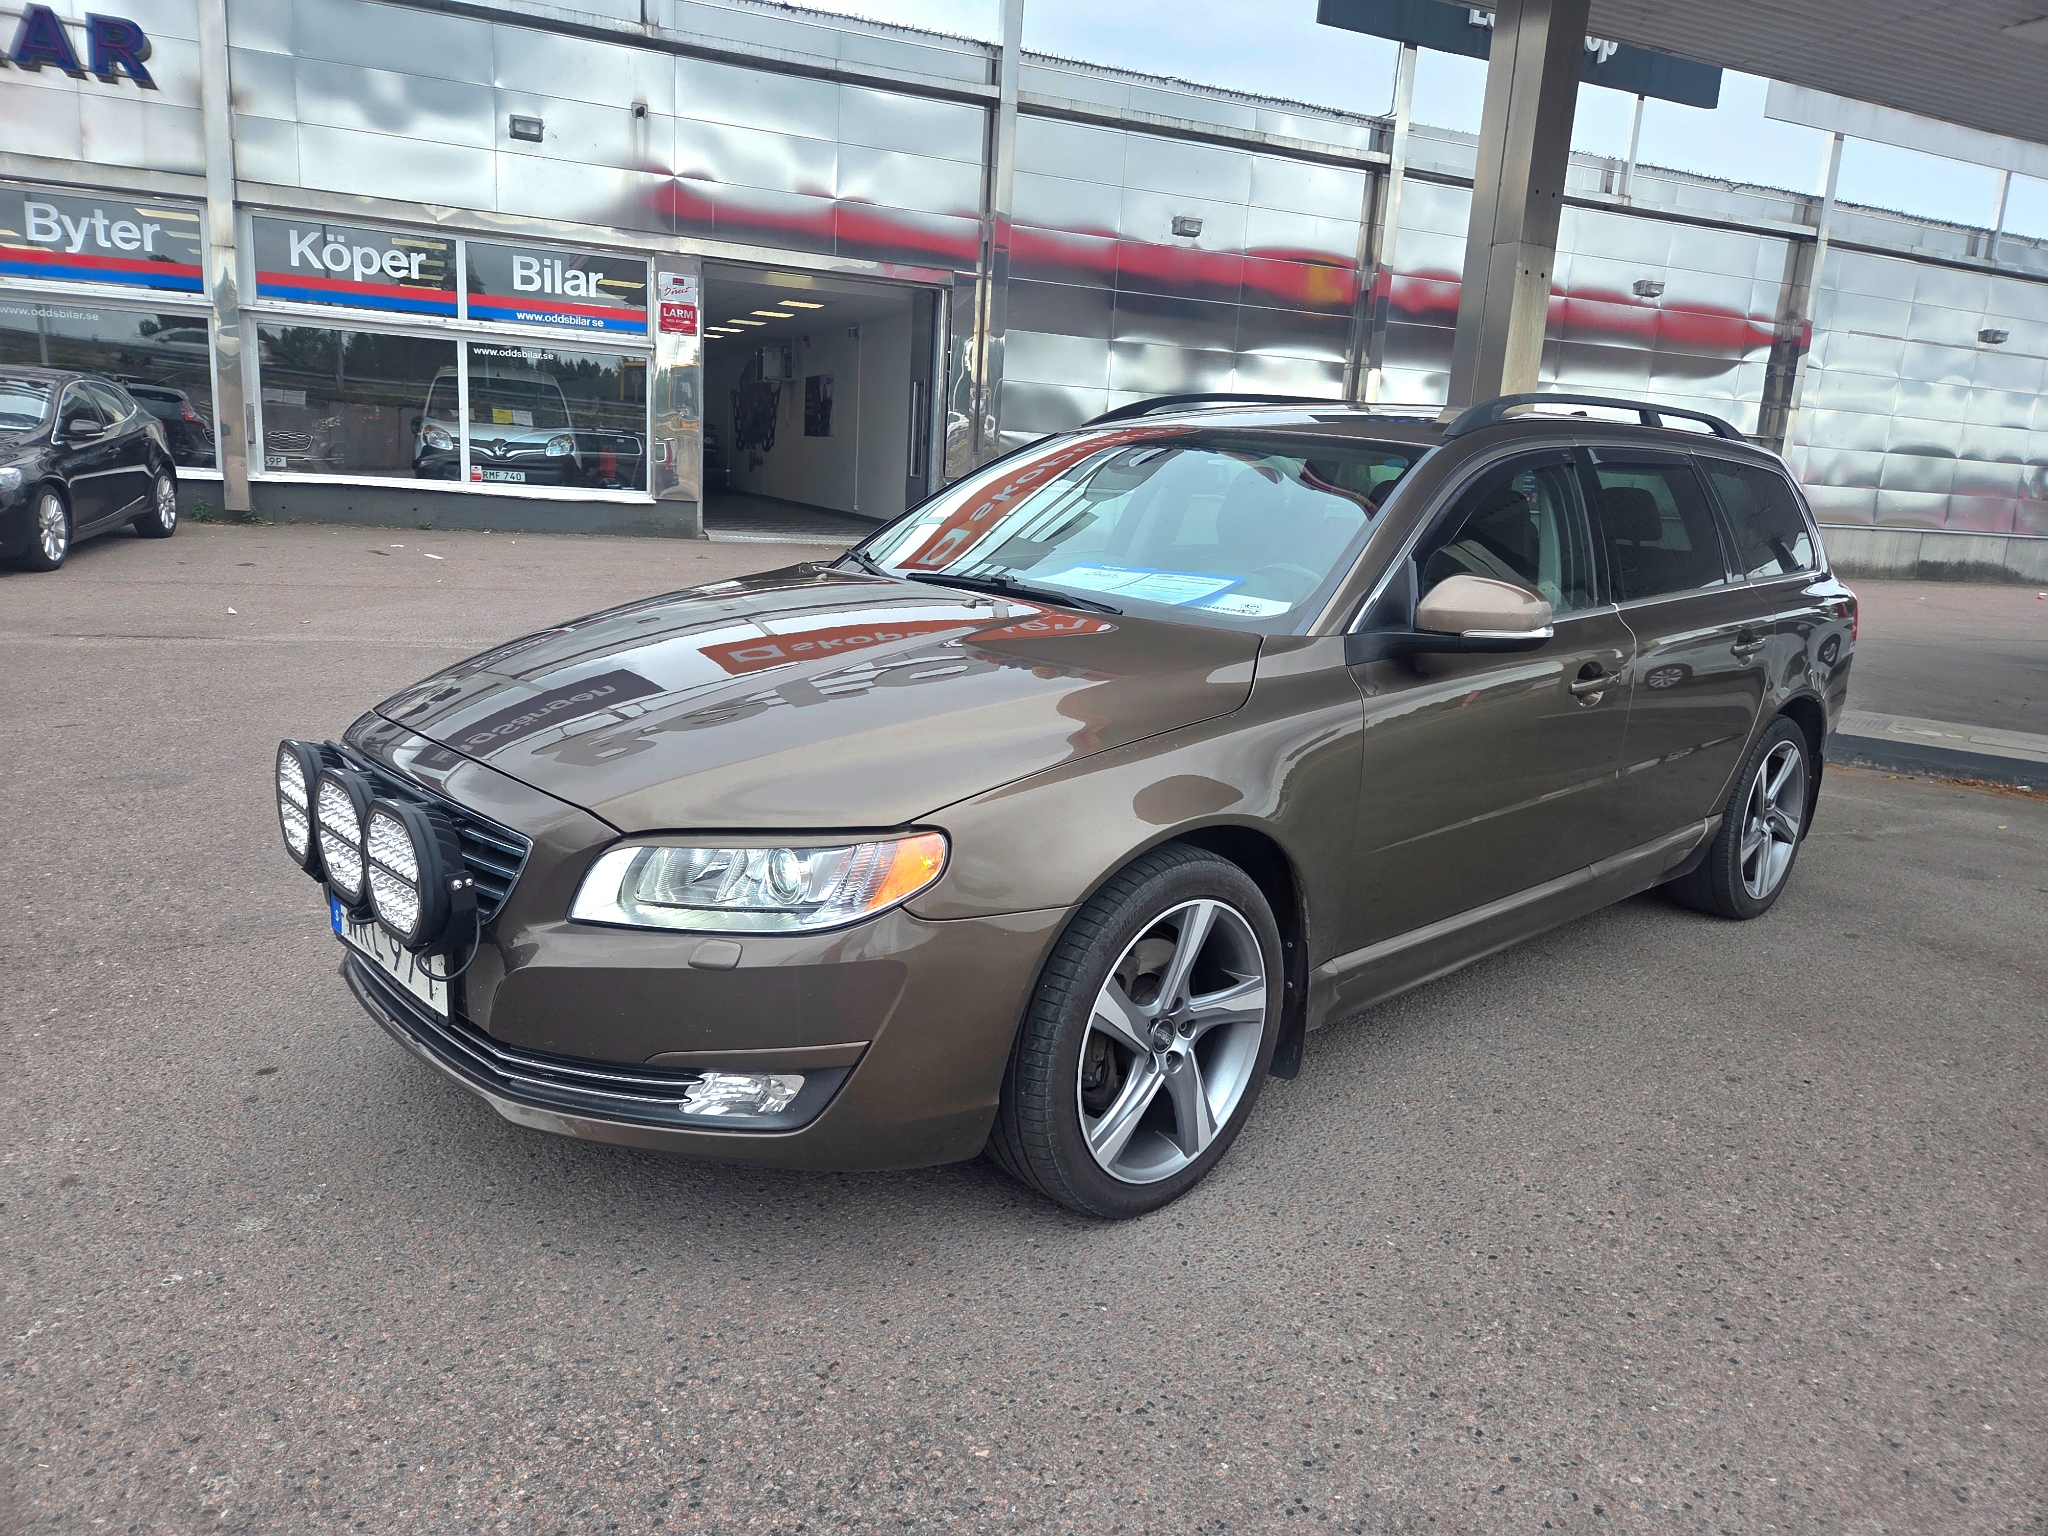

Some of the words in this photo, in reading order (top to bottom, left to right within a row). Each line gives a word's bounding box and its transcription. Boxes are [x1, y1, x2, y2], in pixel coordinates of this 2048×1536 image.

[0, 2, 158, 90] AR
[24, 200, 160, 253] Byter
[289, 229, 427, 281] Köper
[512, 255, 603, 298] Bilar
[663, 307, 693, 319] LARM
[473, 346, 554, 360] www.oddsbilar.se
[483, 470, 500, 479] RMF
[504, 472, 522, 481] 740
